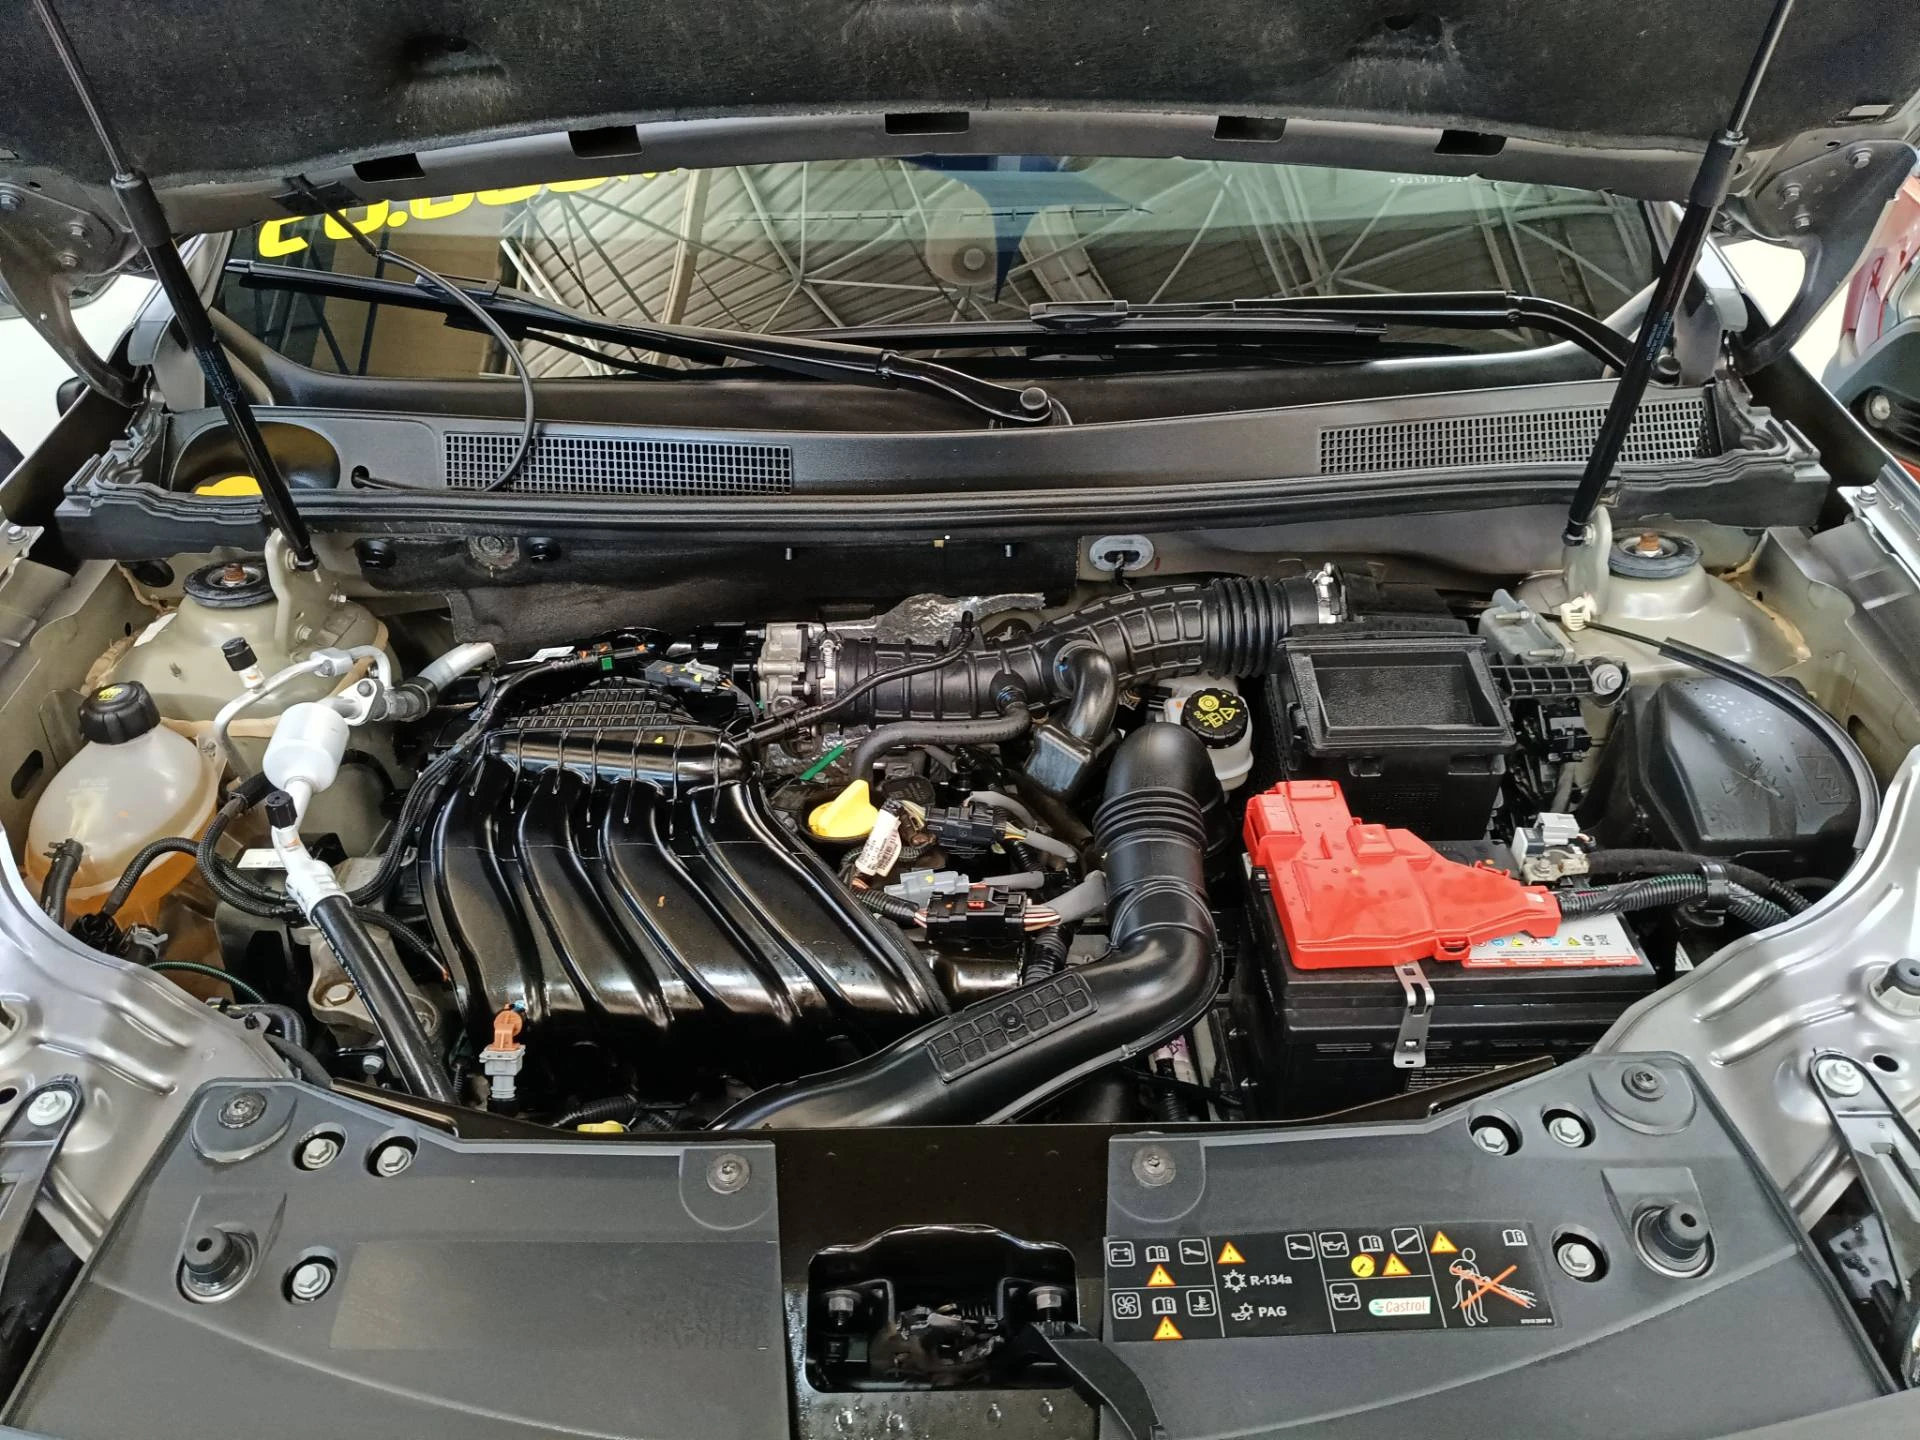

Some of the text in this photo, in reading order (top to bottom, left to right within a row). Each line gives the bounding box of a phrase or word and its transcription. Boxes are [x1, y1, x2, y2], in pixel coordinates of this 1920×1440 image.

[1249, 1274, 1293, 1286] R-134a
[1258, 1306, 1288, 1318] PAG
[1385, 1300, 1426, 1313] Castrol
